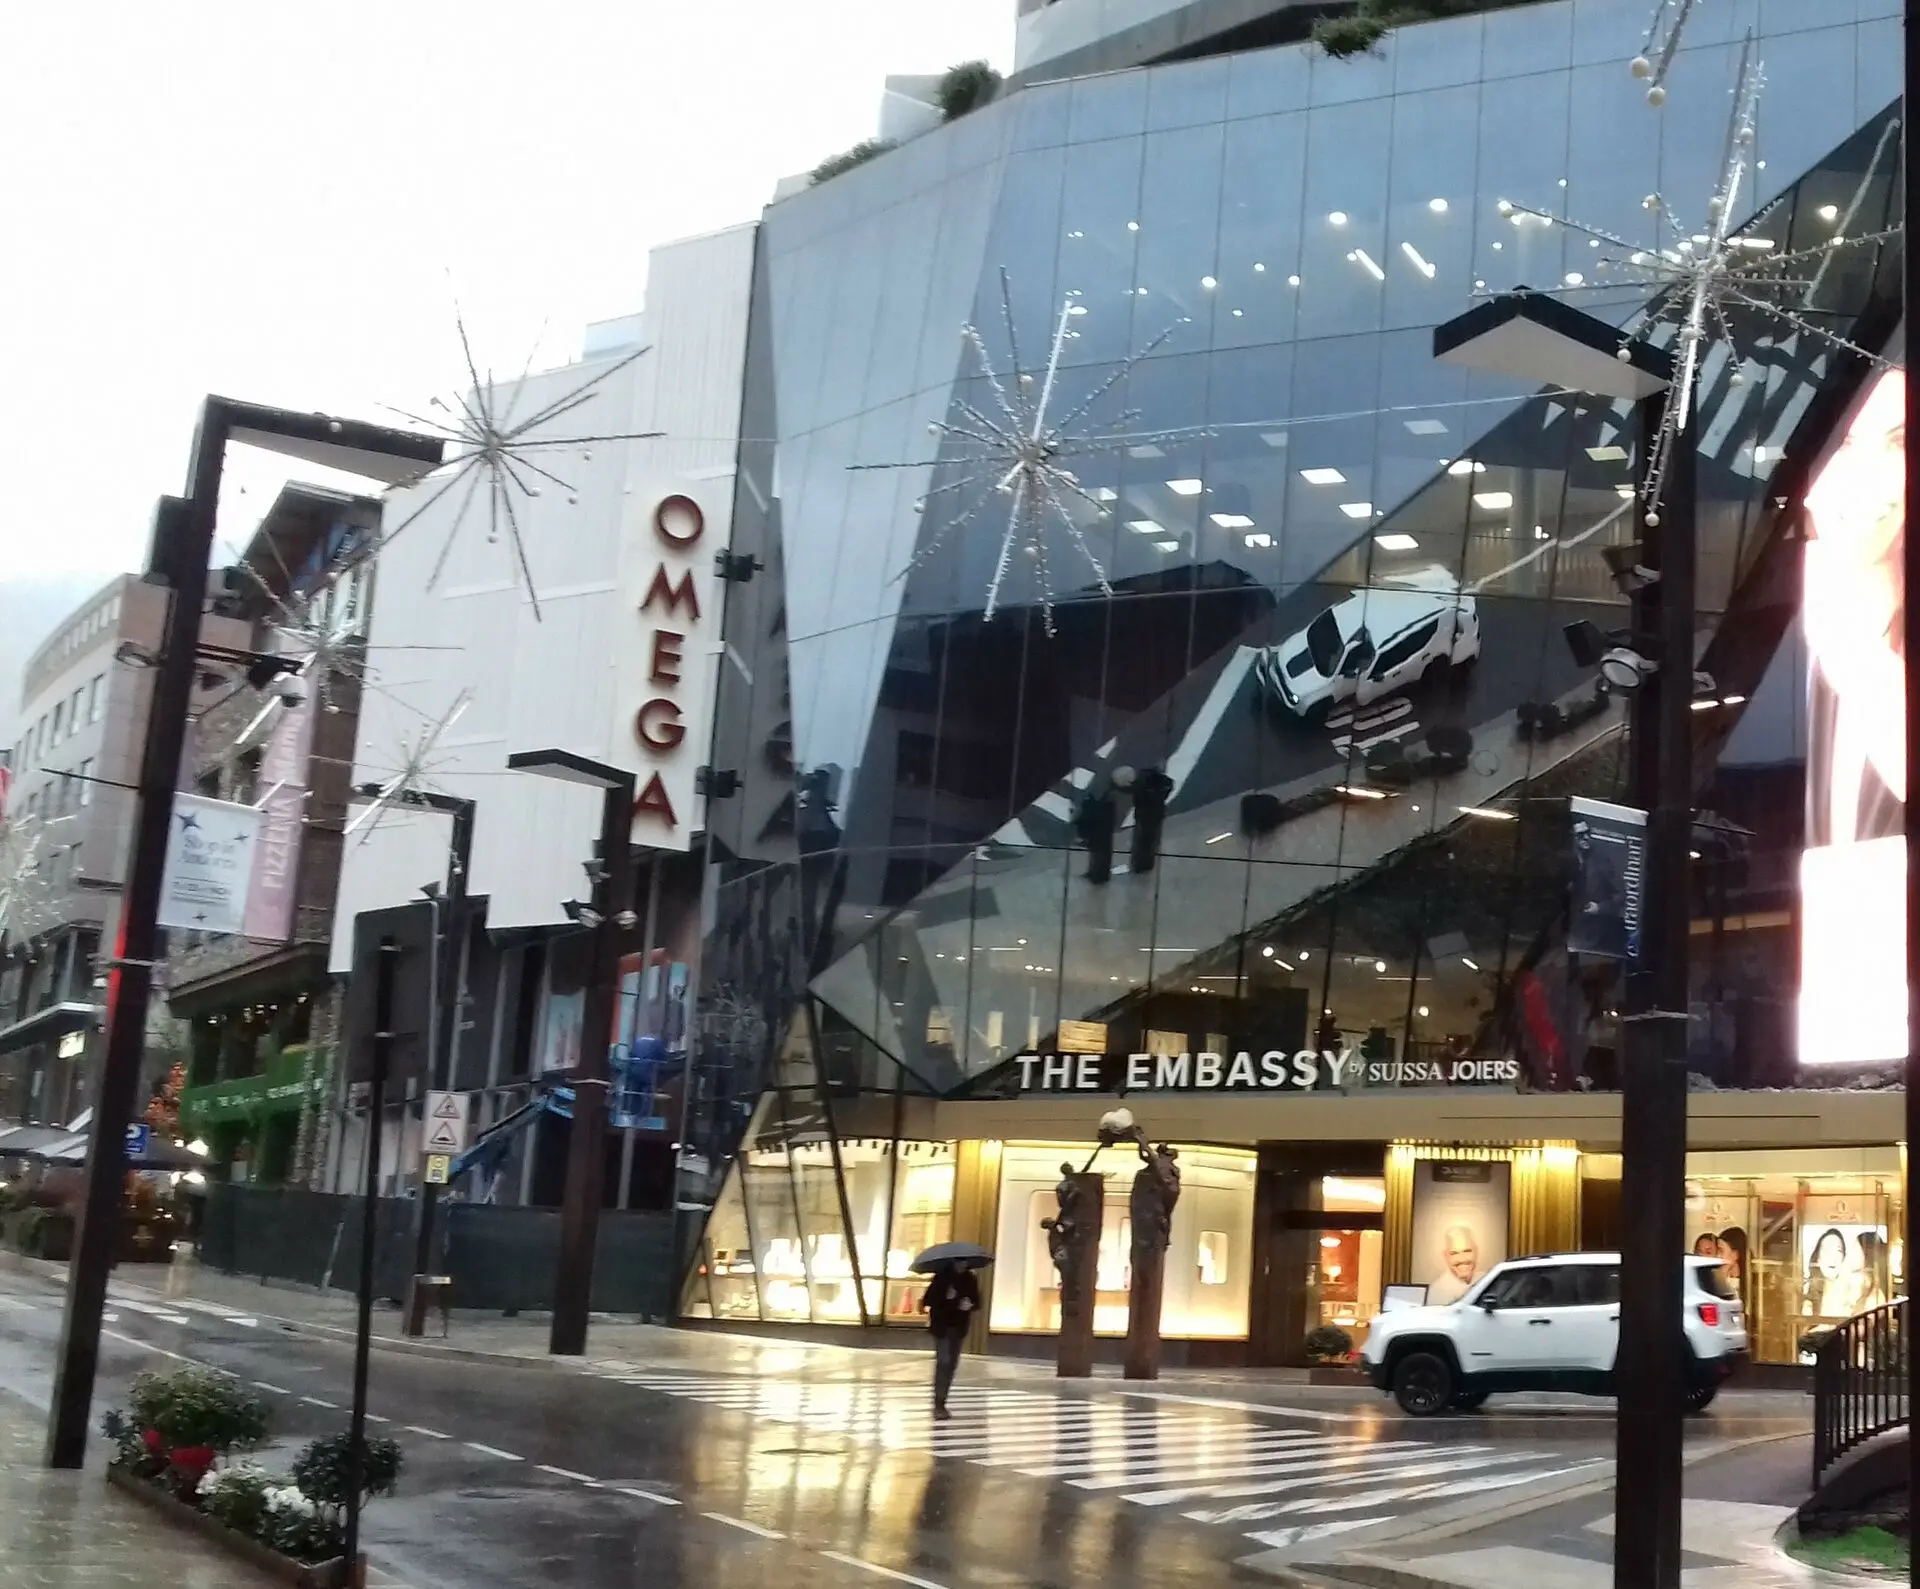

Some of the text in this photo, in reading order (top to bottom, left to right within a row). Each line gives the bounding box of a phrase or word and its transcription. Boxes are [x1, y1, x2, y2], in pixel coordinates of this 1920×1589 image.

[632, 494, 704, 830] OMEGA
[1015, 1050, 1519, 1089] THE EMBASSY by SUISSA JOIERS
